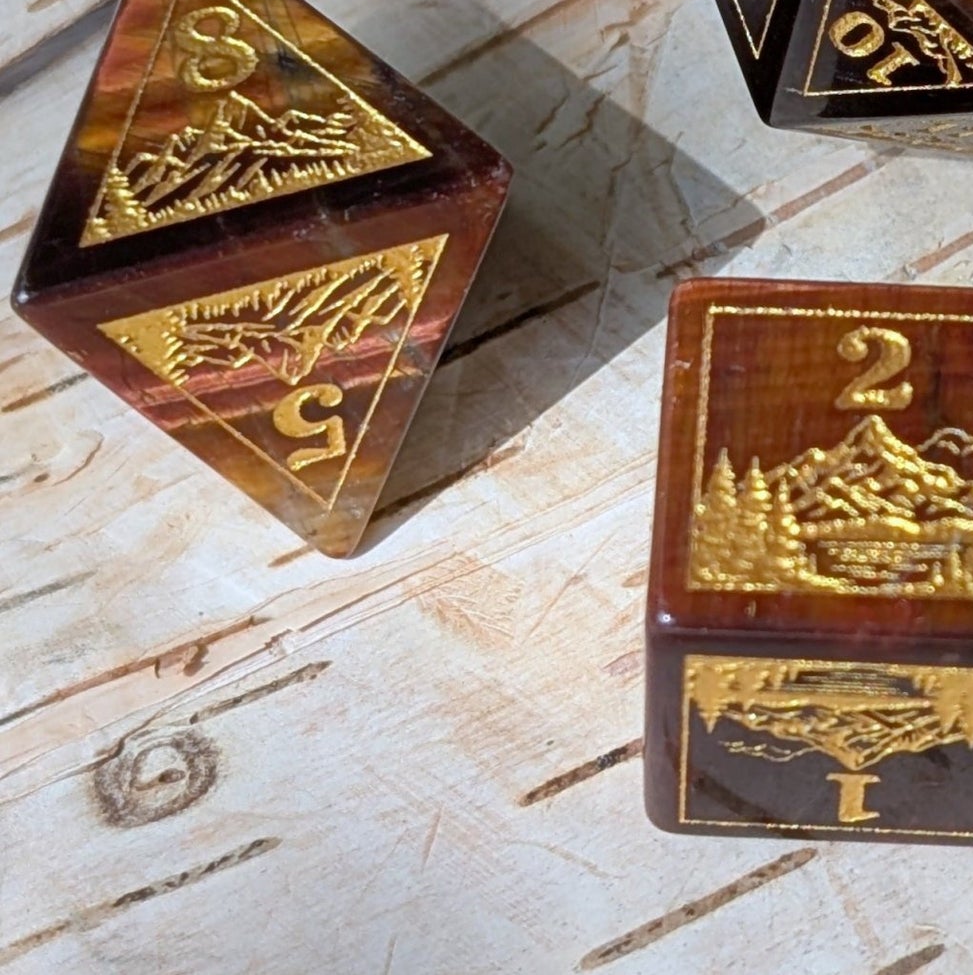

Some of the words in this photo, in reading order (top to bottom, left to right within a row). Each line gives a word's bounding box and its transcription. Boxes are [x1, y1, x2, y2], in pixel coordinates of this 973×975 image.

[174, 5, 260, 93] 8
[827, 10, 922, 88] 10
[834, 324, 915, 411] 2
[272, 383, 346, 472] 5
[824, 772, 881, 823] 1
